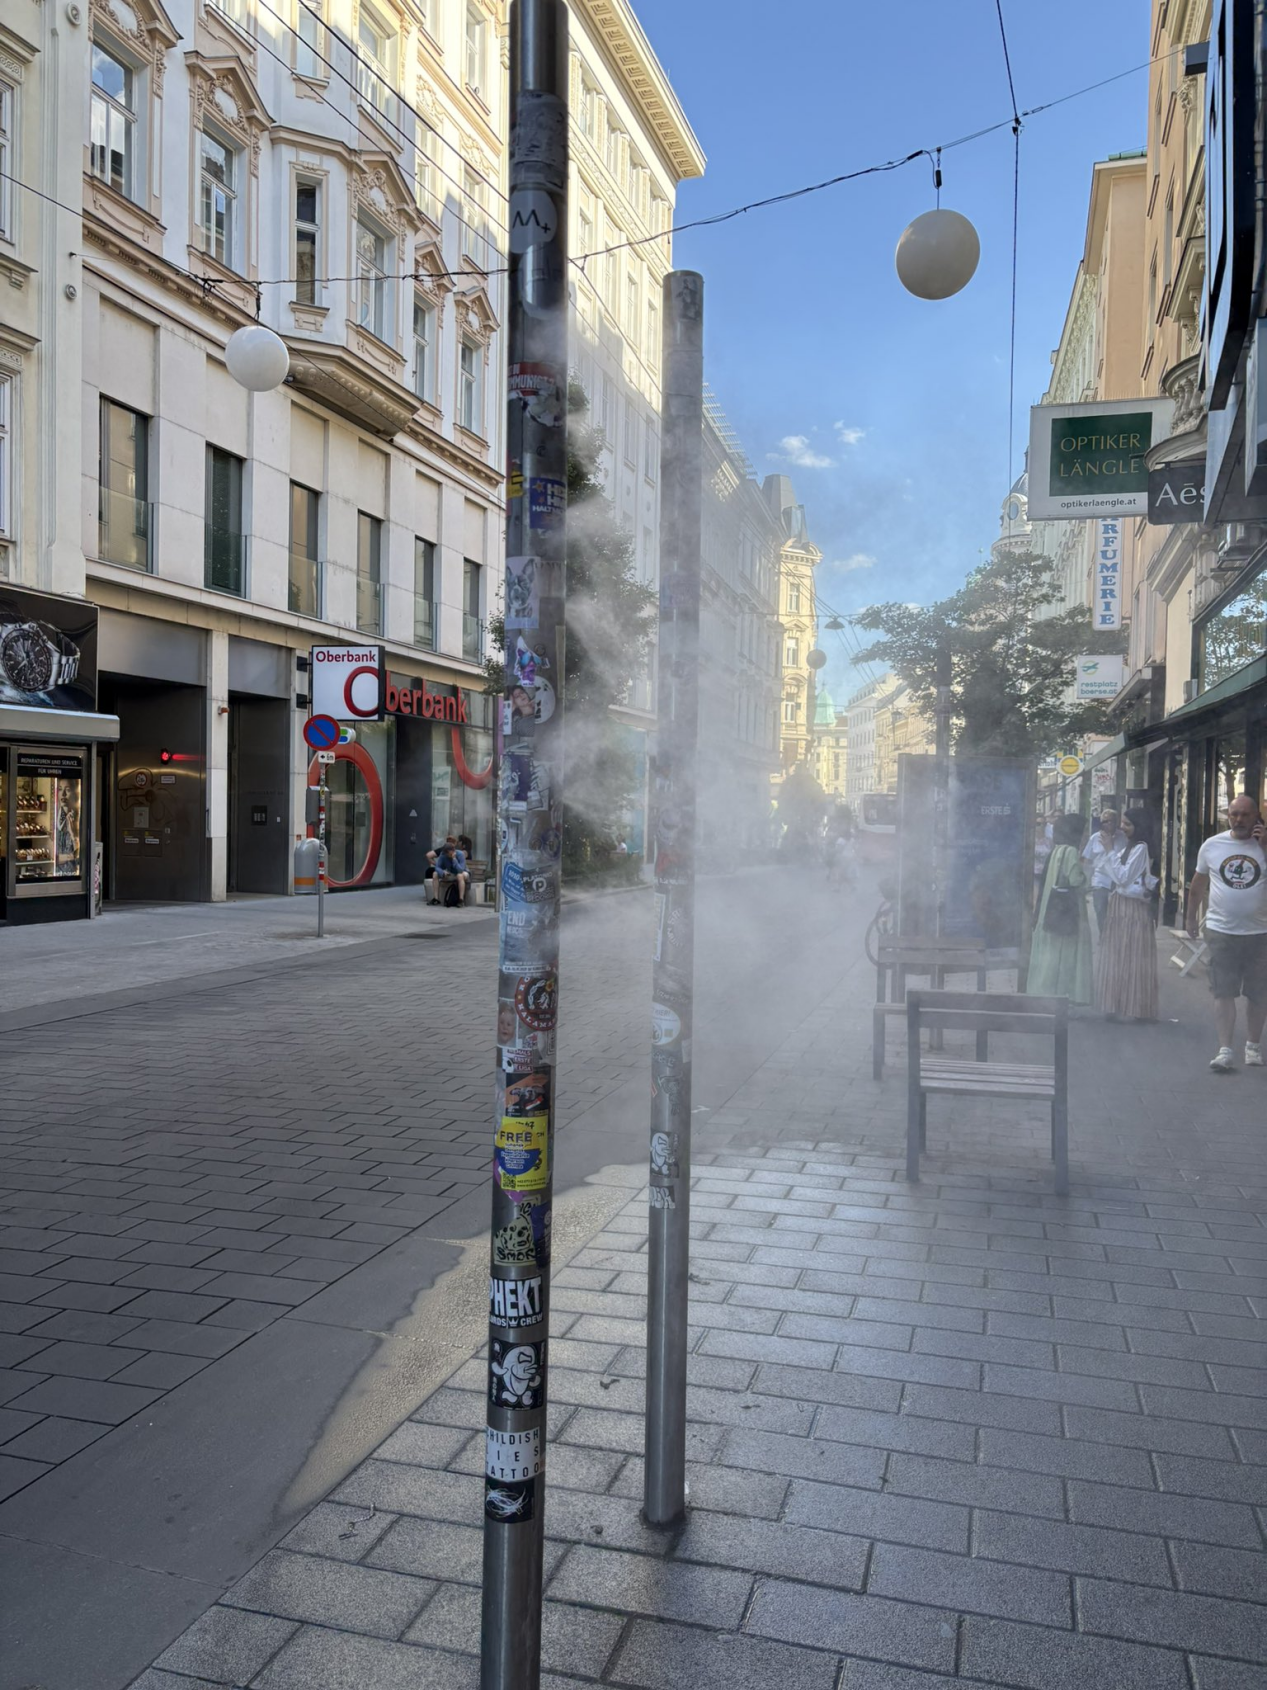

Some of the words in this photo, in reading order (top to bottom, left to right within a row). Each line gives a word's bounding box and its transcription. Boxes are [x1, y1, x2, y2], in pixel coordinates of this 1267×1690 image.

[1060, 433, 1141, 452] OPTIKER
[1060, 458, 1140, 477] LÄNGLE
[1060, 498, 1137, 510] optikerlaengle.at
[1098, 517, 1119, 625] RFUMERIE
[315, 650, 377, 663] Oberbank
[20, 757, 51, 765] REPARATUREN
[980, 805, 1003, 815] ERSTE
[499, 1131, 532, 1143] FREE
[520, 1313, 543, 1326] CREW
